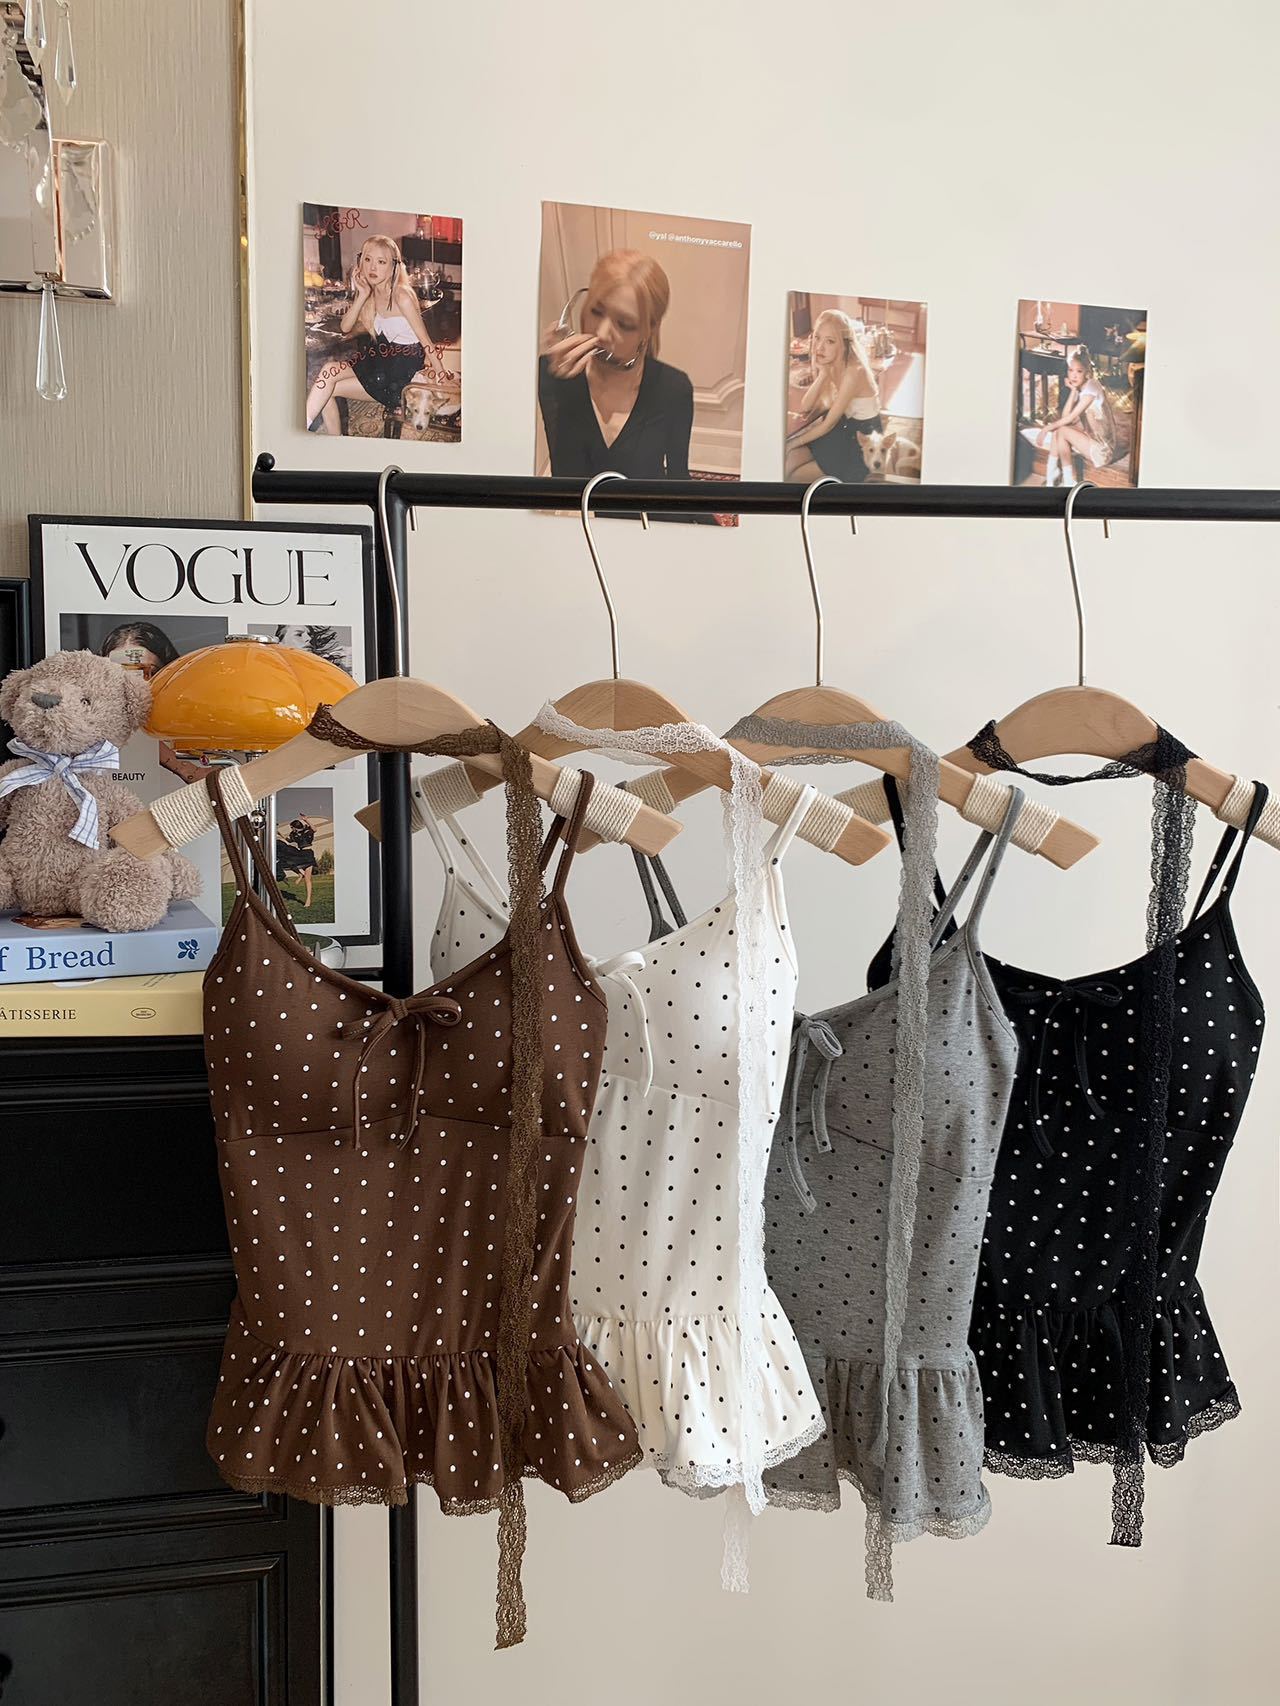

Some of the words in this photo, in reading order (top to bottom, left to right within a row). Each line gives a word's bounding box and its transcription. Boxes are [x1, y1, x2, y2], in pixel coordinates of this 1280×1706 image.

[74, 542, 338, 607] VOGUE
[112, 772, 146, 781] BEAUTY
[25, 940, 116, 971] Bread
